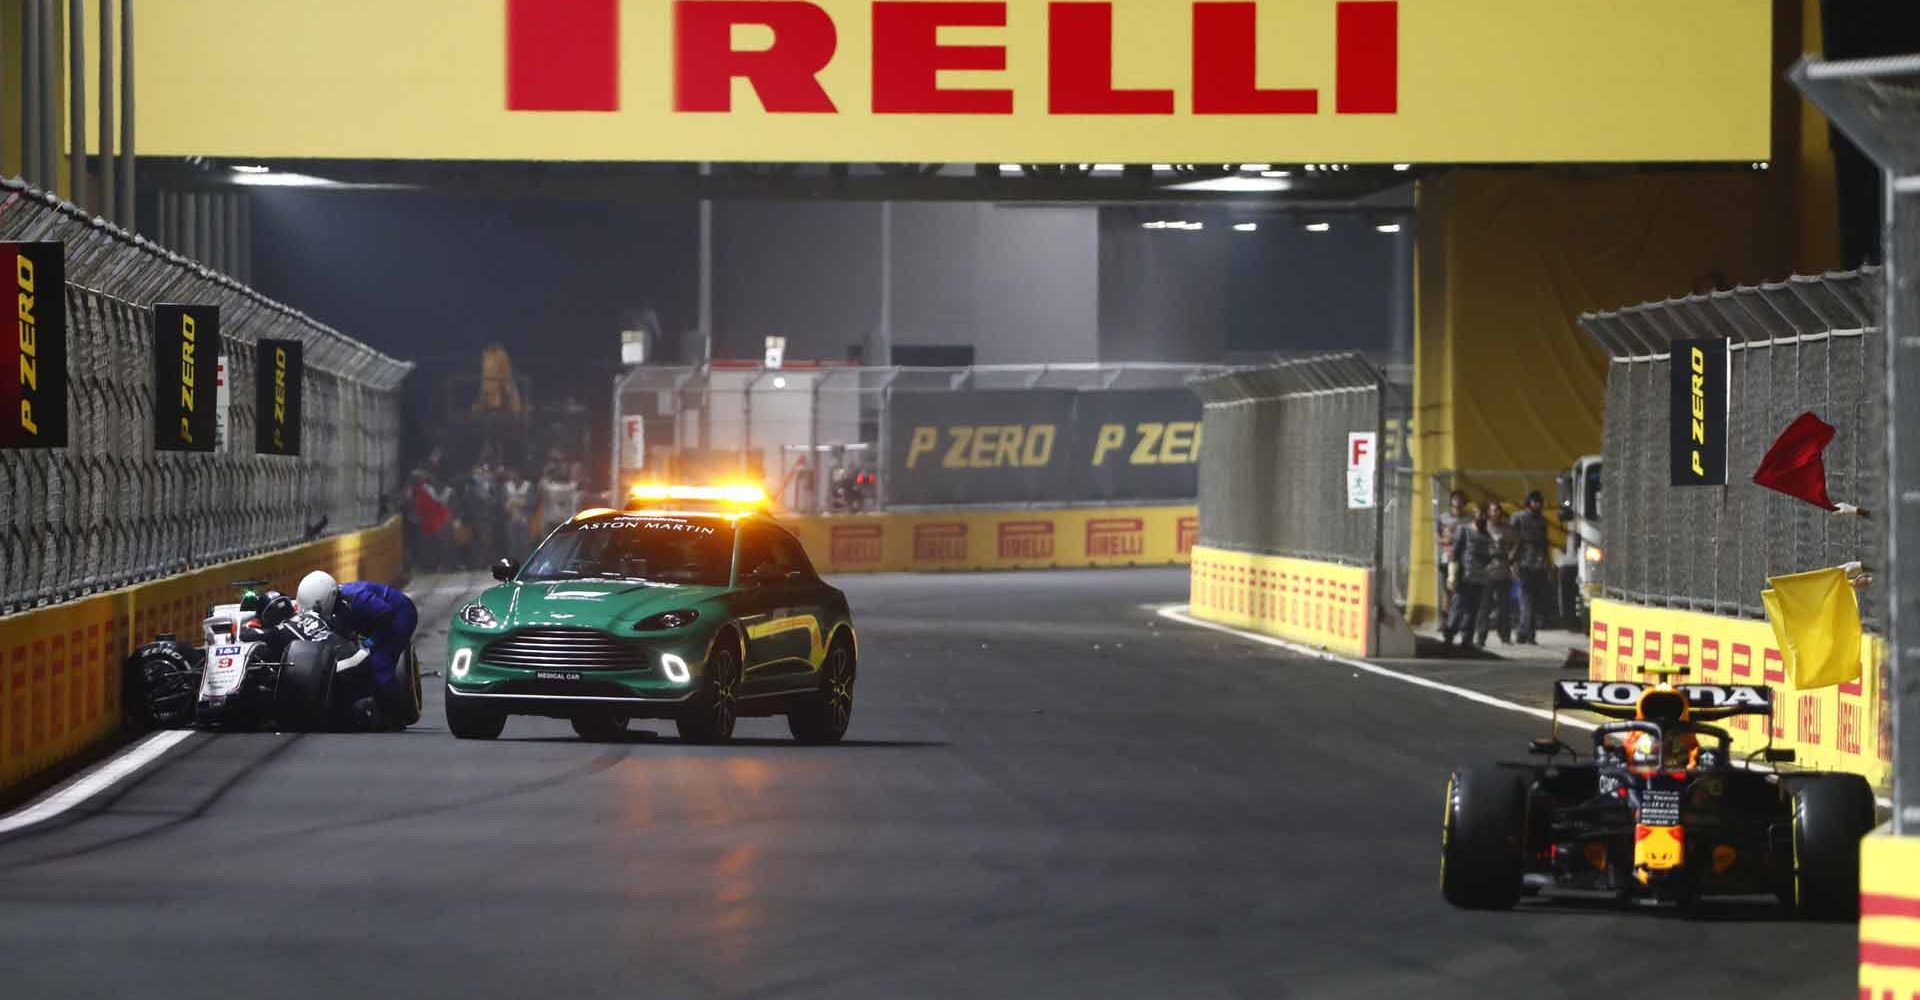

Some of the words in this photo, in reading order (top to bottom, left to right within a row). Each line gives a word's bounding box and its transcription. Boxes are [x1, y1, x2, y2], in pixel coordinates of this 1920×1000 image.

[16, 254, 36, 391] ZERO
[181, 313, 195, 410] ZERO
[274, 347, 286, 424] ZERO
[1690, 346, 1706, 445] ZERO
[19, 400, 38, 435] P
[181, 417, 194, 444] P
[906, 426, 937, 469] P
[942, 423, 1056, 468] ZERO
[1092, 423, 1126, 466] P
[1353, 439, 1368, 465] F
[1690, 449, 1705, 476] P
[578, 522, 638, 530] ASTON
[645, 523, 715, 534] MARTIN
[218, 658, 233, 669] 9
[1560, 681, 1769, 706] HODA
